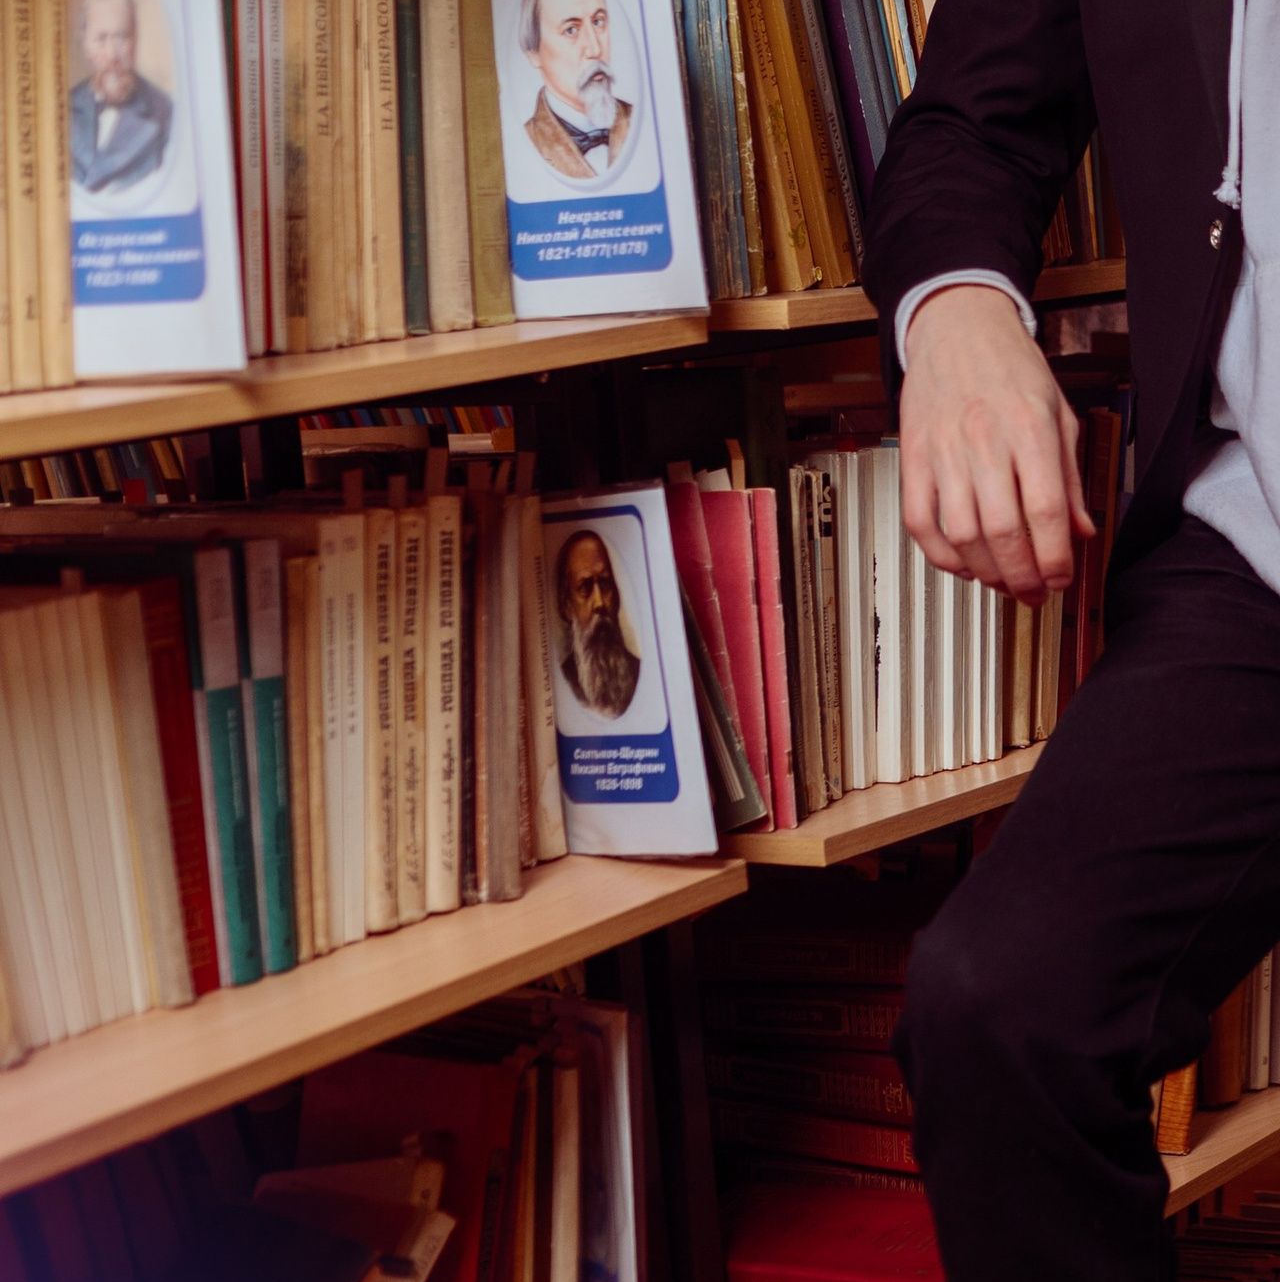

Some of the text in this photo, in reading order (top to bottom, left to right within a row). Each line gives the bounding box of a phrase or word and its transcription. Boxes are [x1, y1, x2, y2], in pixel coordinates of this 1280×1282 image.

[804, 86, 830, 161] Толстой
[516, 223, 664, 246] Николай Алексеевич
[557, 209, 624, 225] Некрасов
[377, 654, 391, 731] ГОСПОДА
[404, 645, 417, 722] ГОСПОДА
[440, 636, 454, 713] ГОСПОДА
